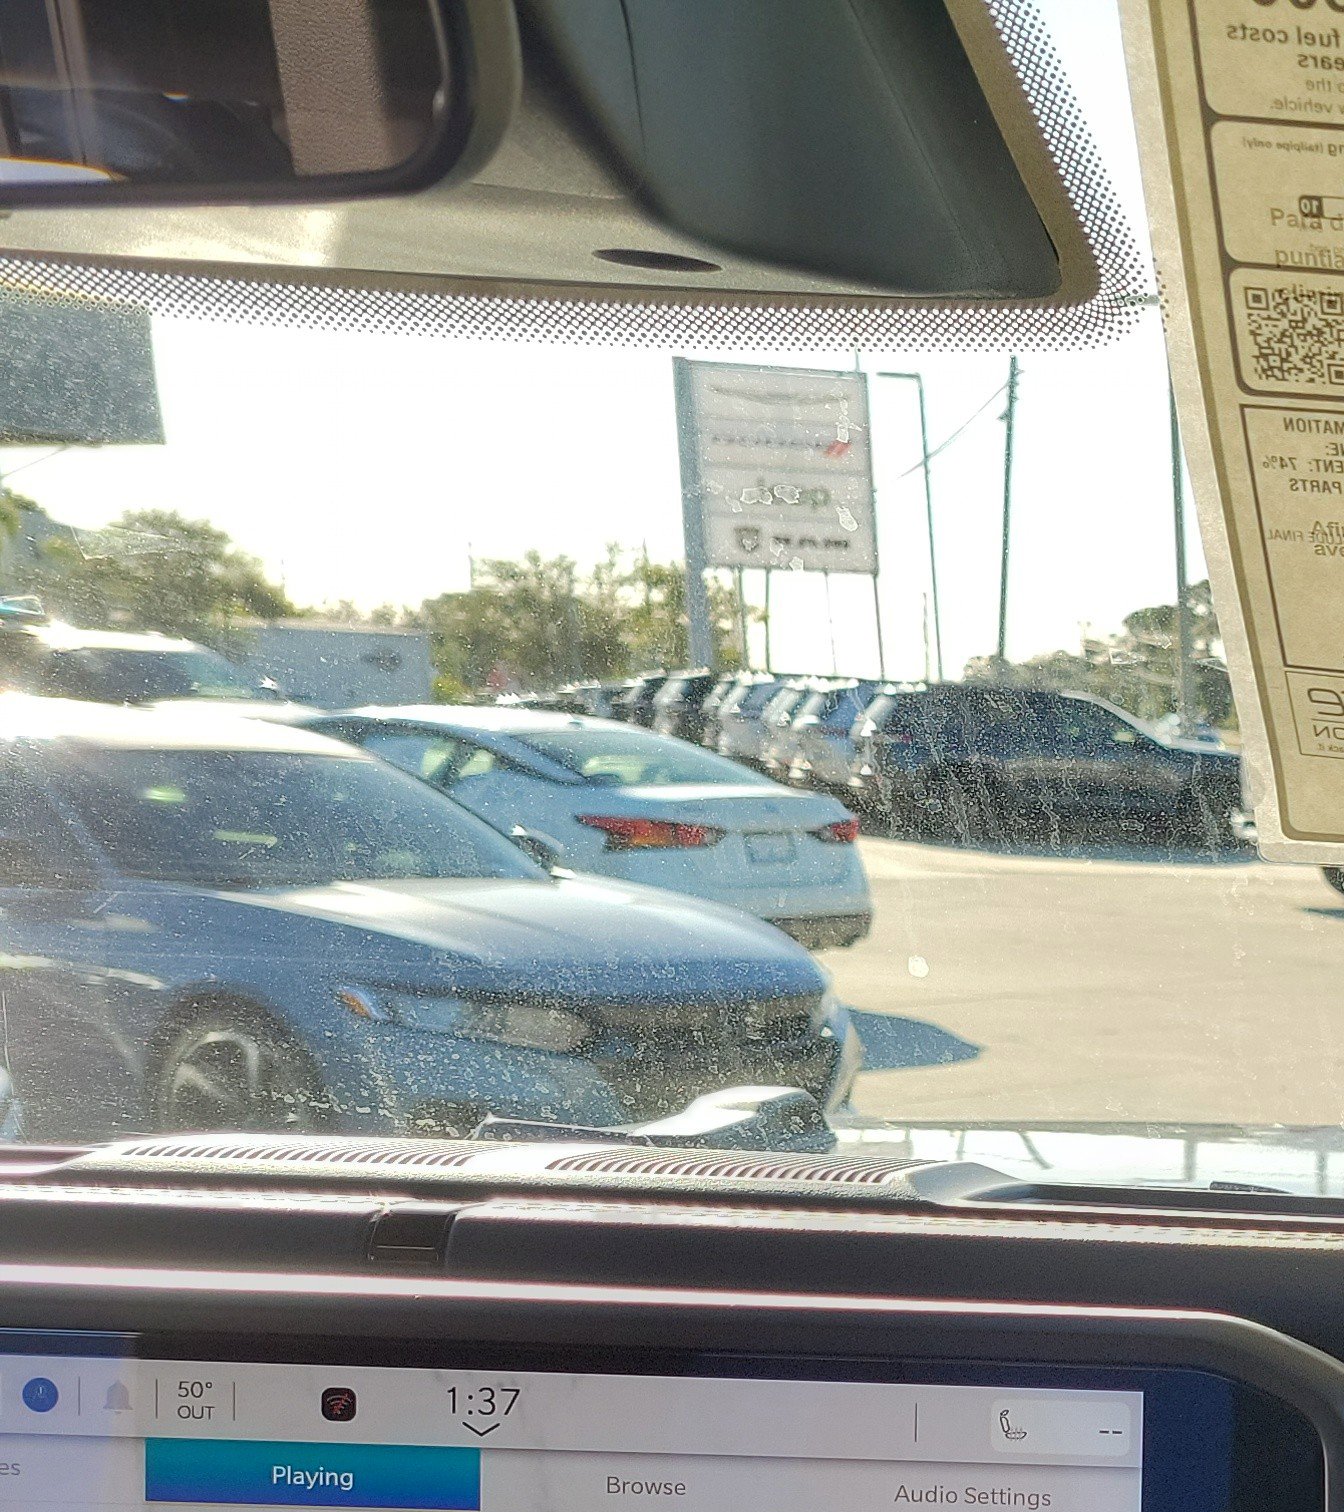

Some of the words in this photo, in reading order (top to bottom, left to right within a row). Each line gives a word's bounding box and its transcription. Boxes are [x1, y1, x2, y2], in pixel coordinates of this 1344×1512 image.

[176, 1380, 214, 1400] 50°
[447, 1386, 521, 1417] 1:37
[176, 1404, 215, 1422] OUT
[271, 1464, 355, 1491] Playing
[605, 1475, 687, 1496] Browse
[893, 1485, 959, 1506] Audio
[963, 1486, 1052, 1510] Settings
